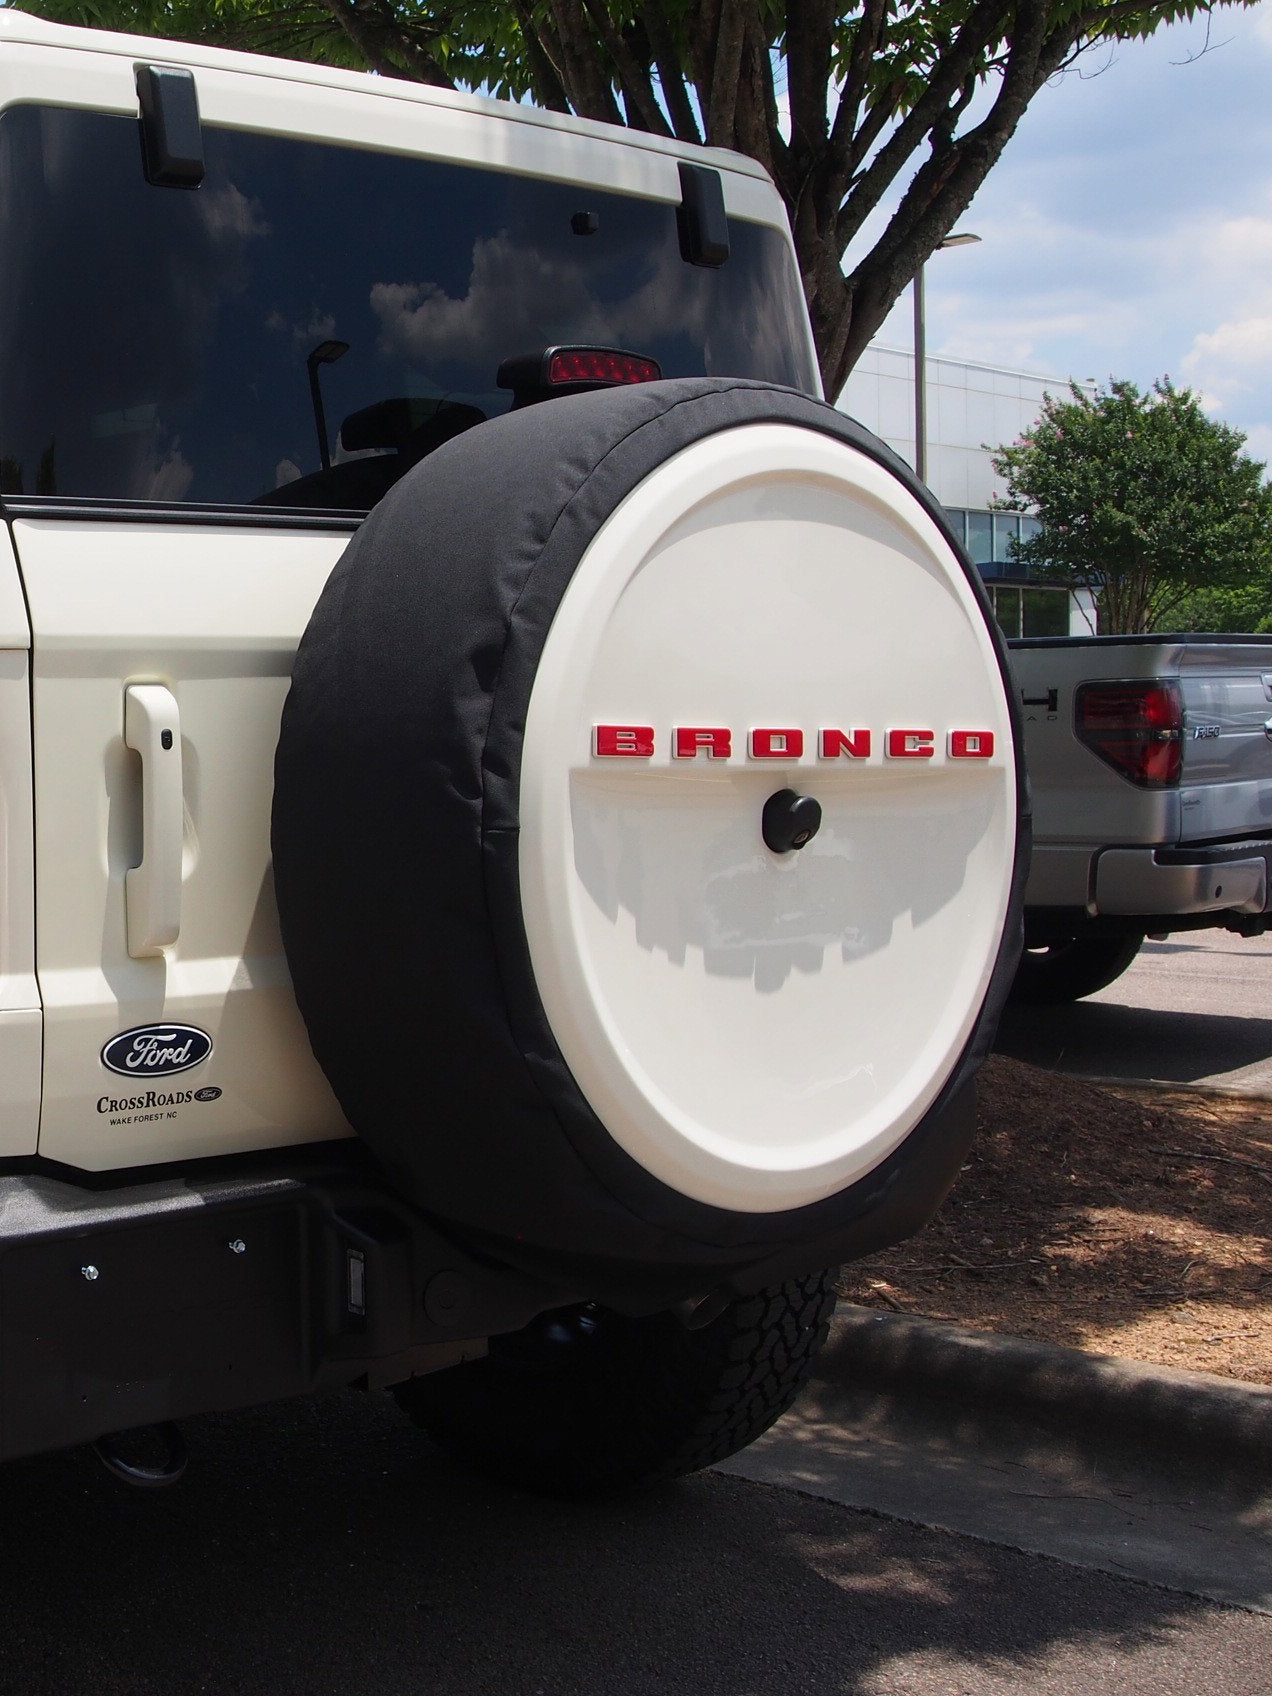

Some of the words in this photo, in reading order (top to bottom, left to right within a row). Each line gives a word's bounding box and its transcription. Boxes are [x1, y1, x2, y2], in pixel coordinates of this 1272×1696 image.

[593, 723, 995, 759] BRONCO
[125, 1033, 194, 1068] Ford
[110, 1116, 132, 1126] WAKE
[133, 1113, 164, 1123] FOREST
[166, 1111, 178, 1119] NC
